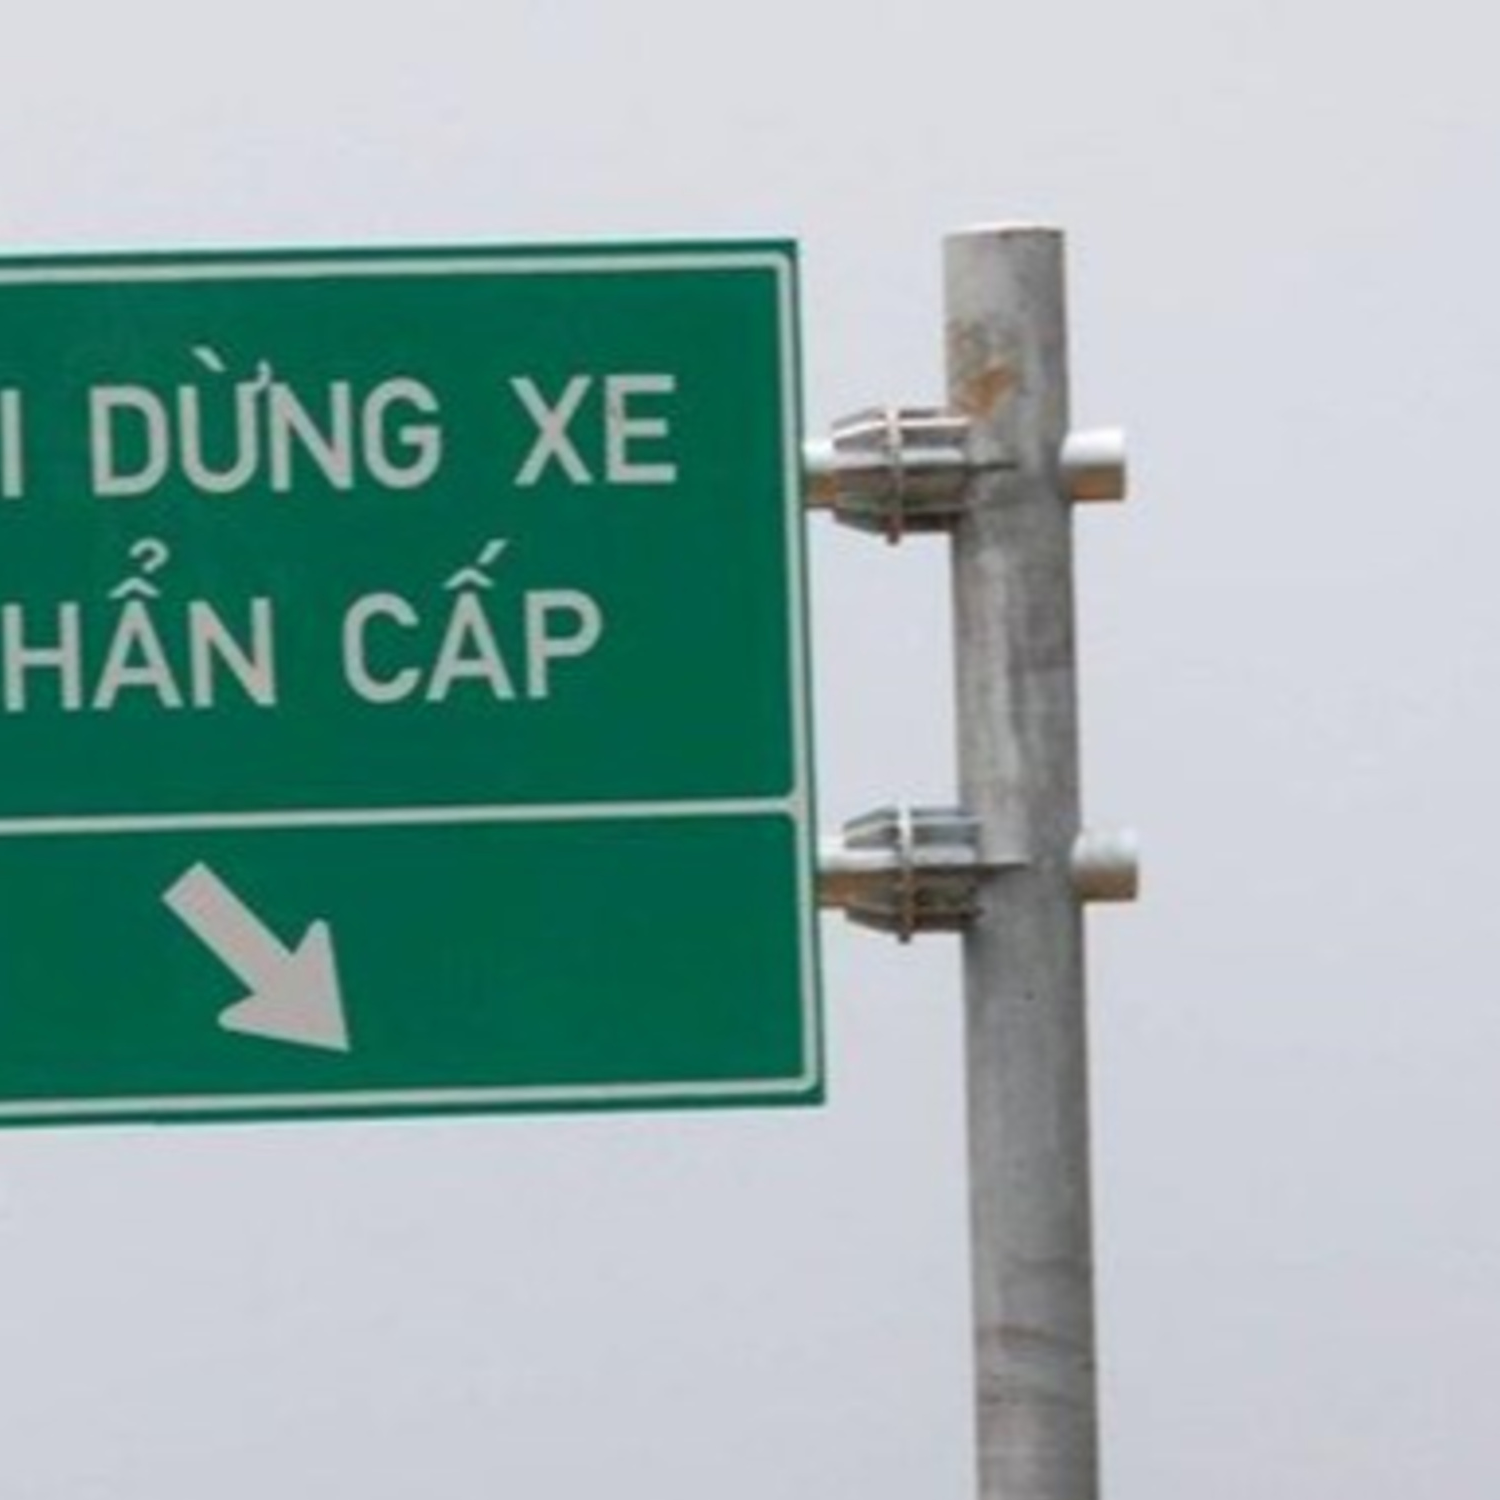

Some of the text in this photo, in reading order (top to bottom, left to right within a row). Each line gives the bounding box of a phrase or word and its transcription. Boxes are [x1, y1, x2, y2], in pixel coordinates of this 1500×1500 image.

[88, 346, 442, 496] DỪNG
[511, 373, 678, 486] XE
[341, 538, 604, 703] CẤP
